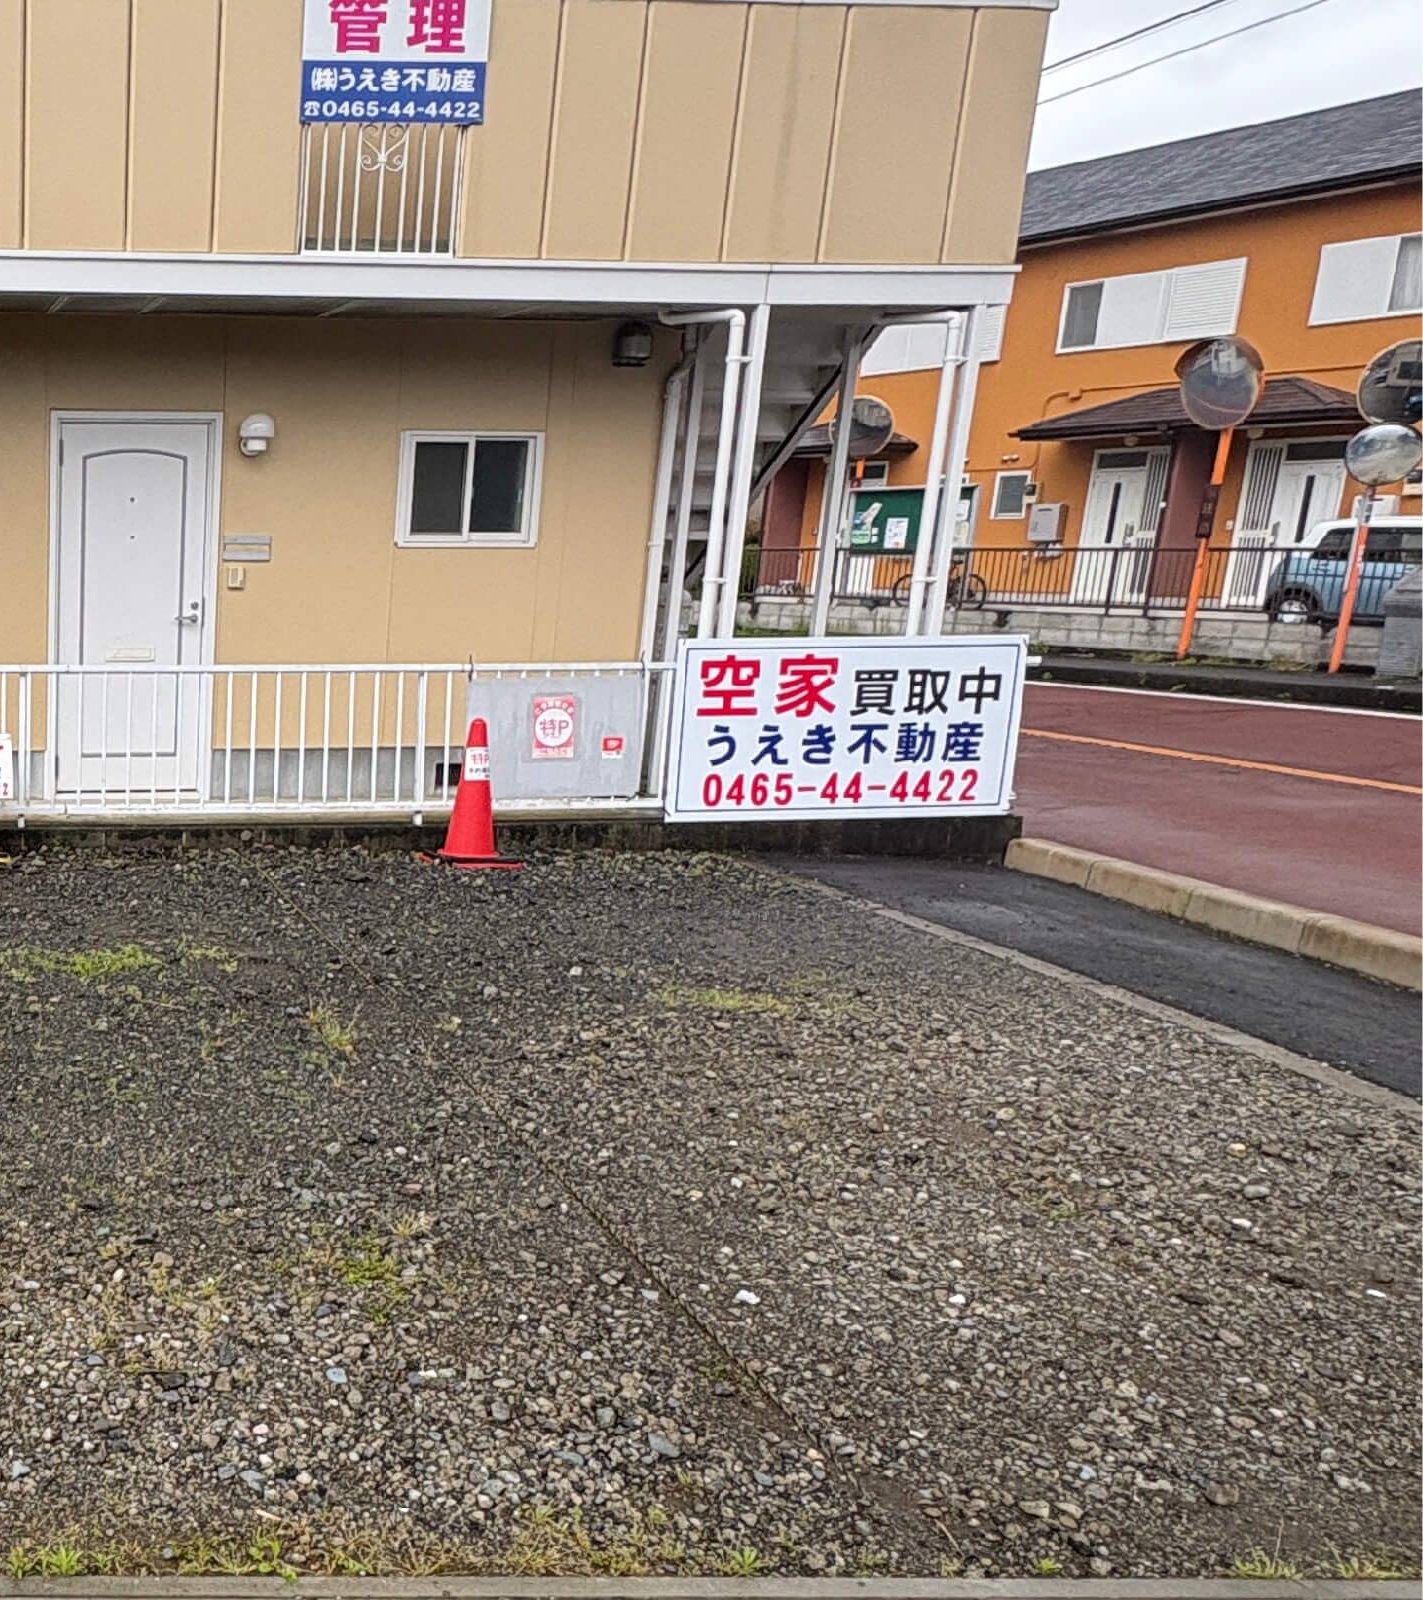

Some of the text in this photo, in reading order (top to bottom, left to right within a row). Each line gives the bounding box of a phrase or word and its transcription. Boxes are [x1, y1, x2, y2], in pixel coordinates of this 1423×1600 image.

[328, 0, 466, 53] 管理
[322, 100, 480, 118] 0465-44-4422
[707, 721, 985, 765] うえき不動産
[703, 769, 979, 807] 0465-44-4422
